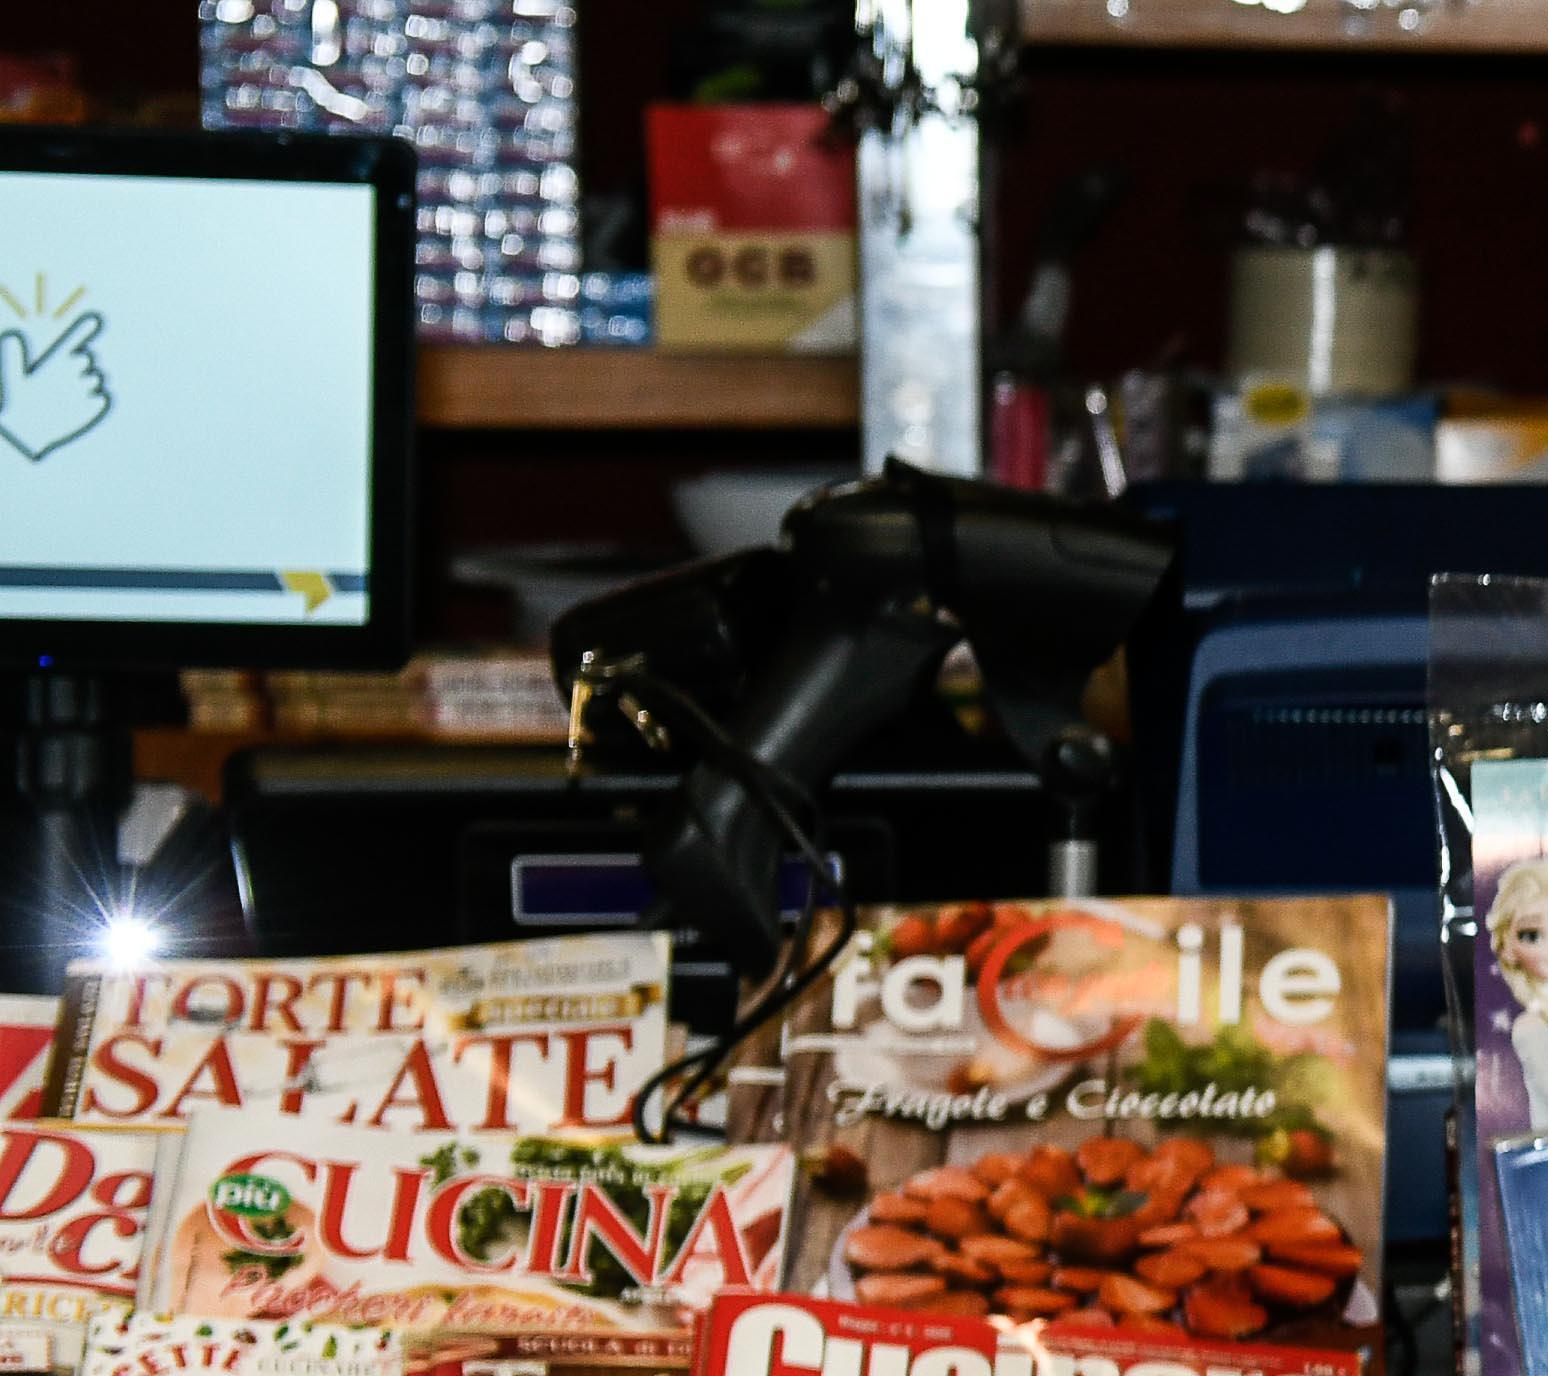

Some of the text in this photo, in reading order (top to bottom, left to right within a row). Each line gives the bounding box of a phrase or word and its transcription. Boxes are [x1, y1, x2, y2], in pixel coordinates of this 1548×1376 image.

[686, 242, 818, 289] OCB
[116, 967, 431, 1034] TORTE
[81, 1024, 639, 1134] SALATE
[826, 1078, 1277, 1130] Fragole e Cioccolato
[207, 1150, 757, 1296] CUCINA
[214, 1177, 282, 1215] più
